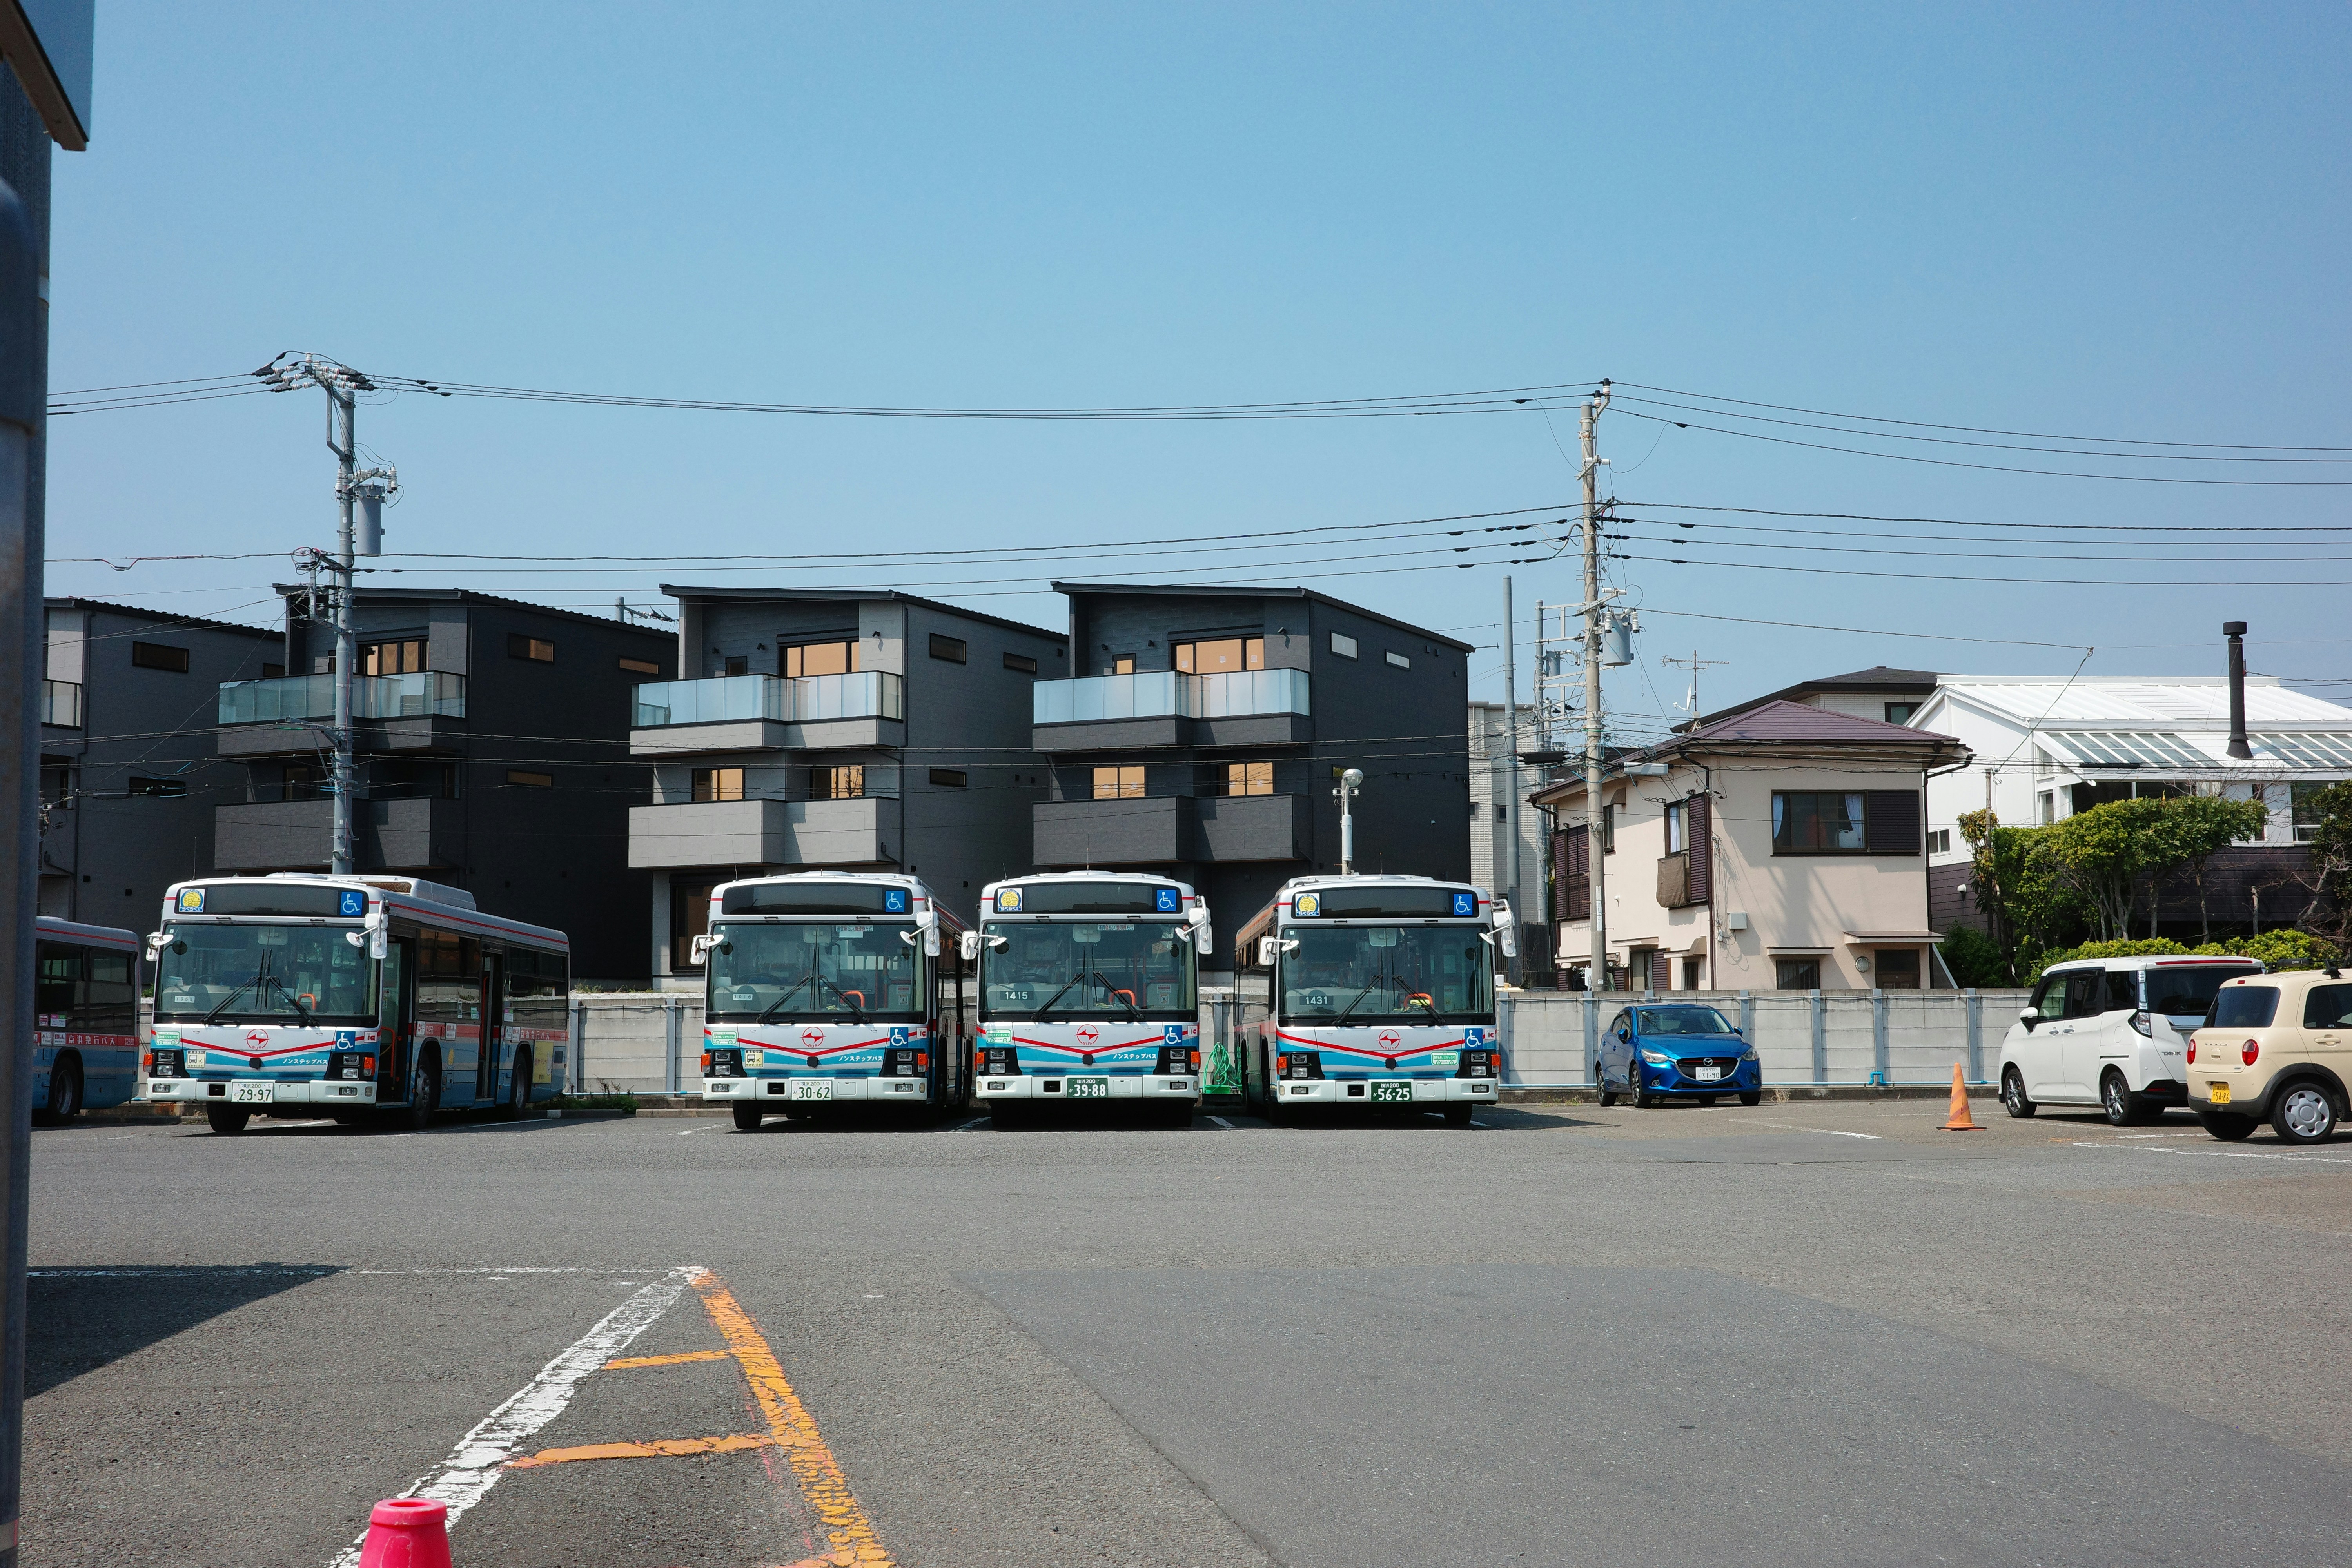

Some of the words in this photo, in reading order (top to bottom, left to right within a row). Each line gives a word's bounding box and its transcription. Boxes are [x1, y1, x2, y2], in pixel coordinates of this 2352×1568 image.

[1005, 991, 1028, 1000] 1415
[1306, 996, 1327, 1005] 1431
[68, 1035, 115, 1045] 京浜急行バス
[520, 1030, 550, 1040] 京浜急行バス
[239, 1089, 271, 1101] 29-97
[799, 1087, 830, 1098] 30-62
[1074, 1084, 1105, 1096] 39-88
[1378, 1088, 1410, 1100] 56-25
[2215, 1092, 2230, 1102] 54-86
